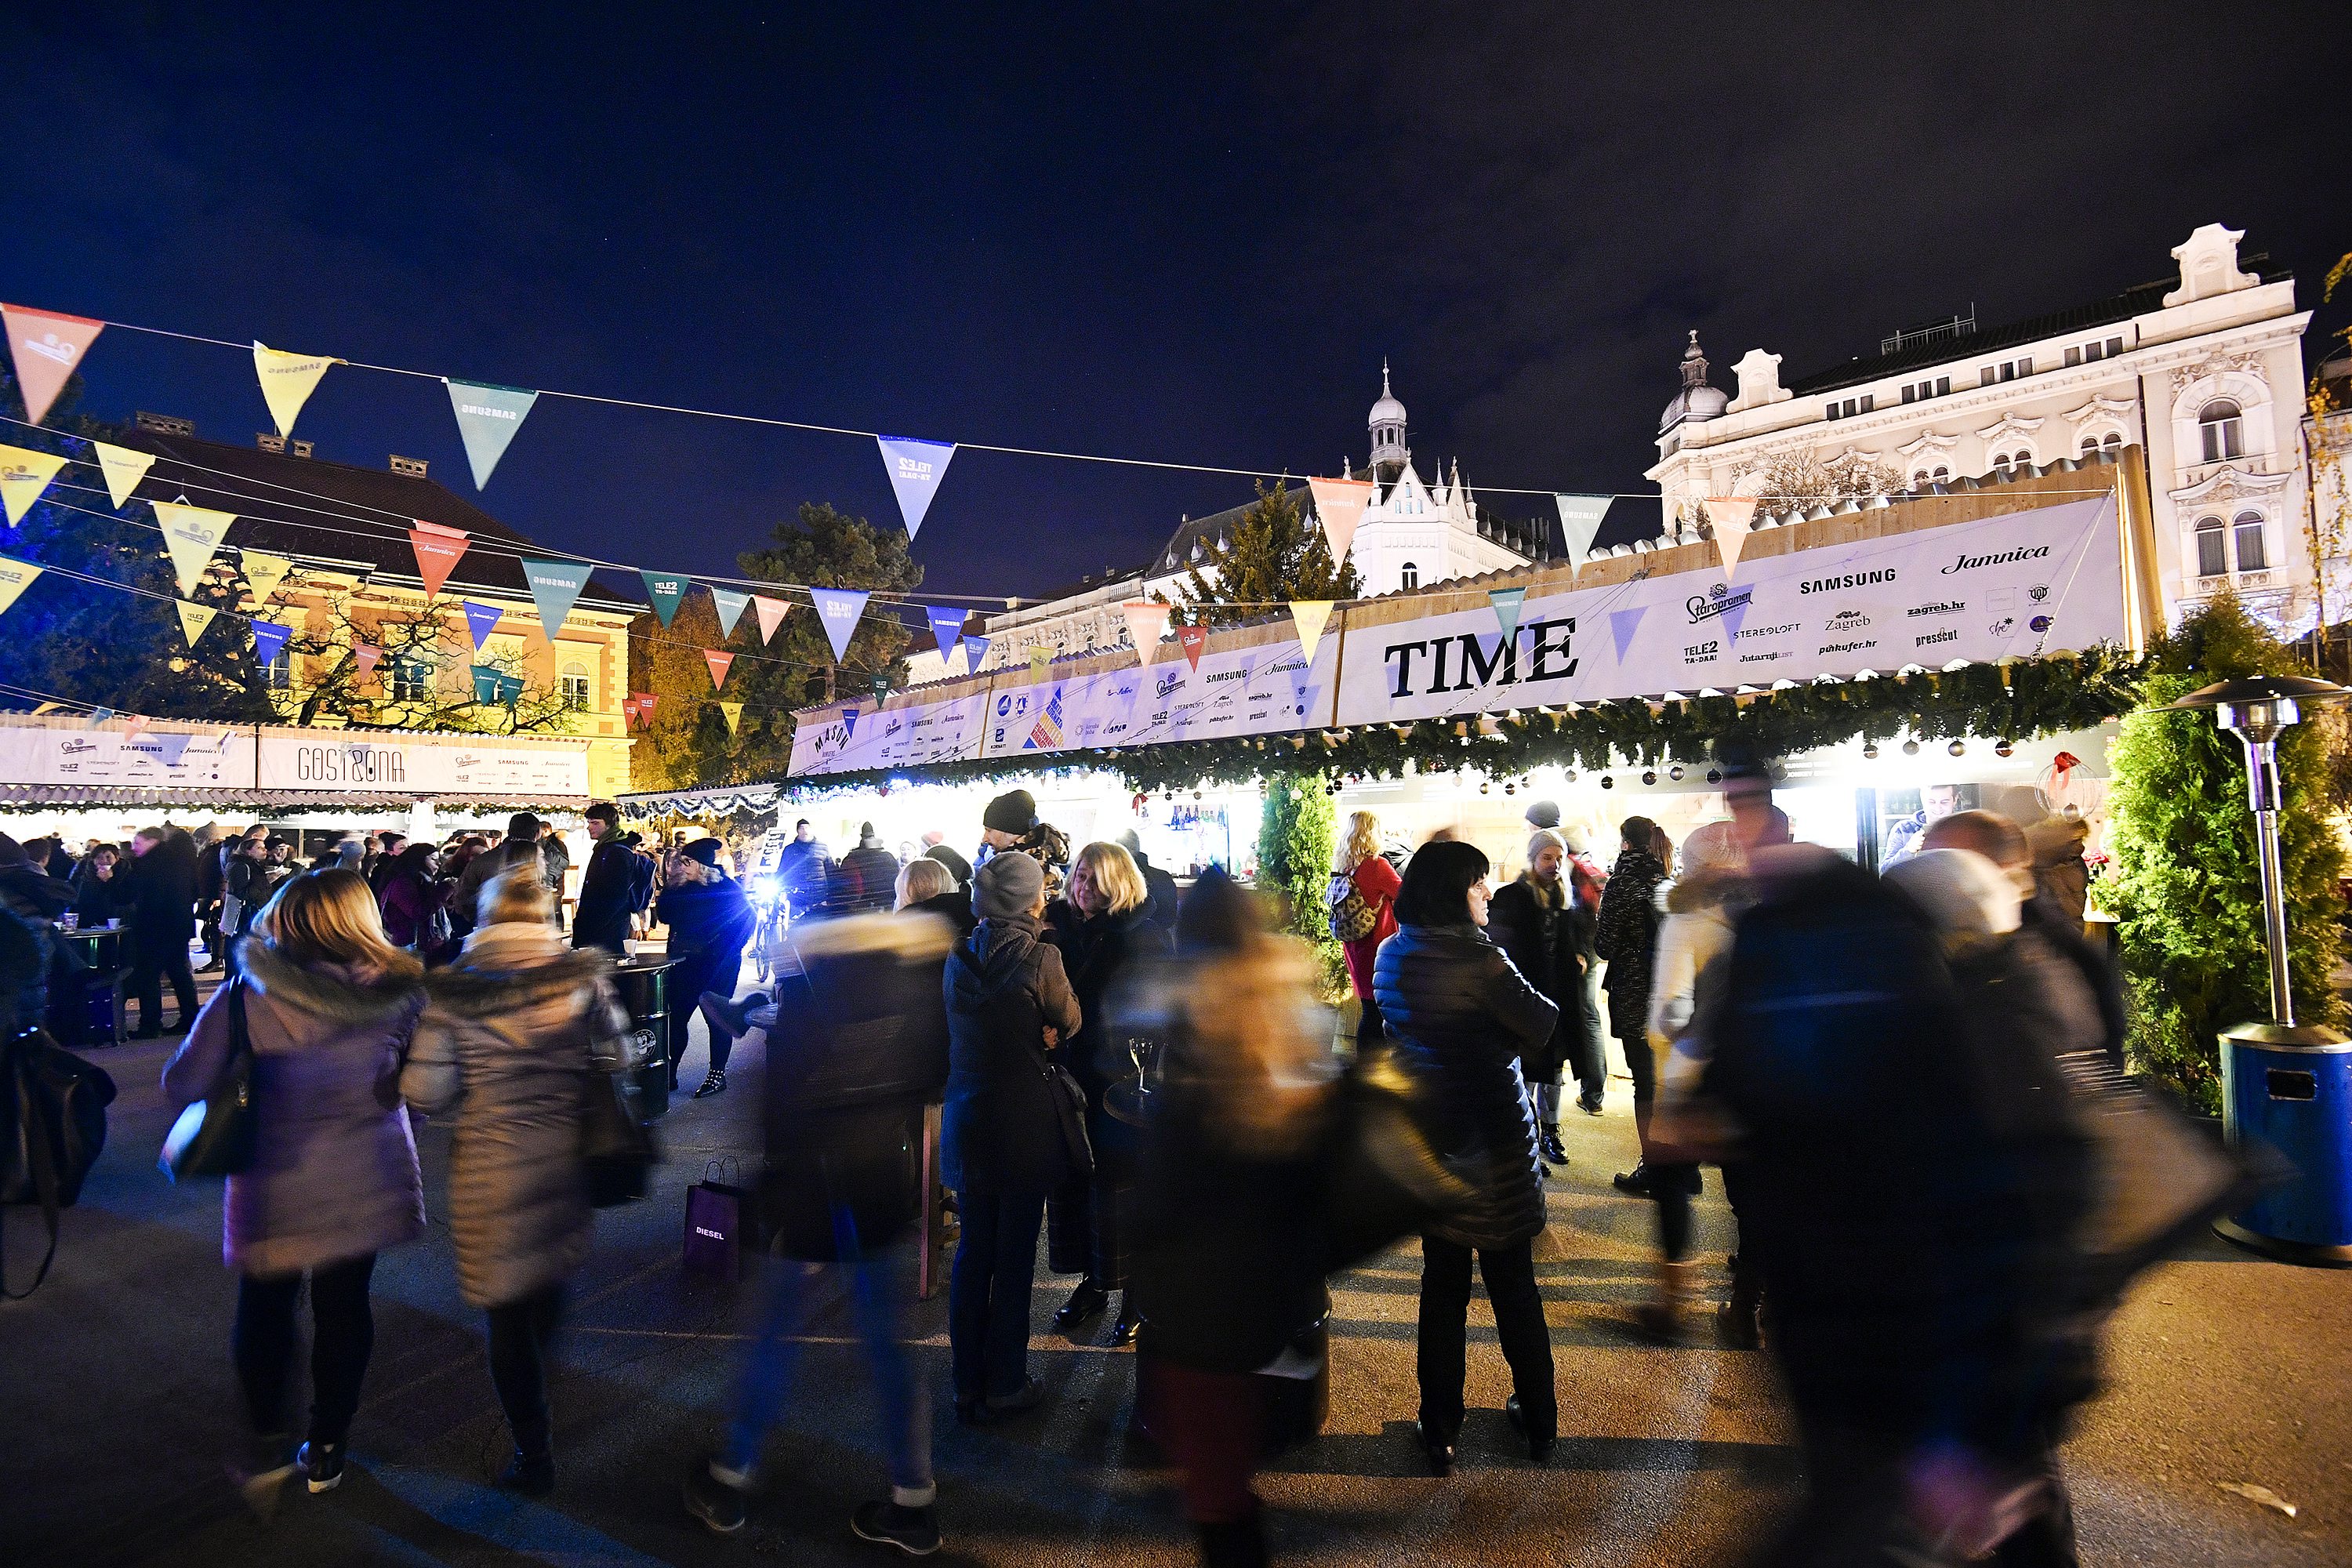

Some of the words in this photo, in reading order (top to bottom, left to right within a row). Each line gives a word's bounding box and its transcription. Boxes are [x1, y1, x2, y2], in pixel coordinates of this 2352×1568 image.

[419, 544, 456, 557] Jamnica
[1940, 546, 2050, 575] Jamnica
[654, 581, 677, 590] TELE2
[1800, 568, 1896, 594] SAMSUNG
[1686, 591, 1754, 624] Staropramen
[1907, 601, 1965, 615] zagreb.hr
[470, 612, 495, 620] Jamnica
[1825, 615, 1871, 631] Zagreb
[256, 630, 283, 640] SAMSUNG
[1733, 623, 1801, 639] STEREOLOFT
[1915, 630, 1958, 647] presscut
[1684, 641, 1718, 656] TELE2
[1385, 617, 1580, 698] TIME
[1685, 655, 1717, 664] TA-DAA!
[1265, 661, 1308, 676] Jamnica
[1206, 670, 1247, 683] SAMSUNG
[1152, 711, 1167, 720] TELE2
[911, 718, 933, 728] SAMSUNG
[815, 724, 848, 753] MASON
[696, 1226, 724, 1240] DIESEL
